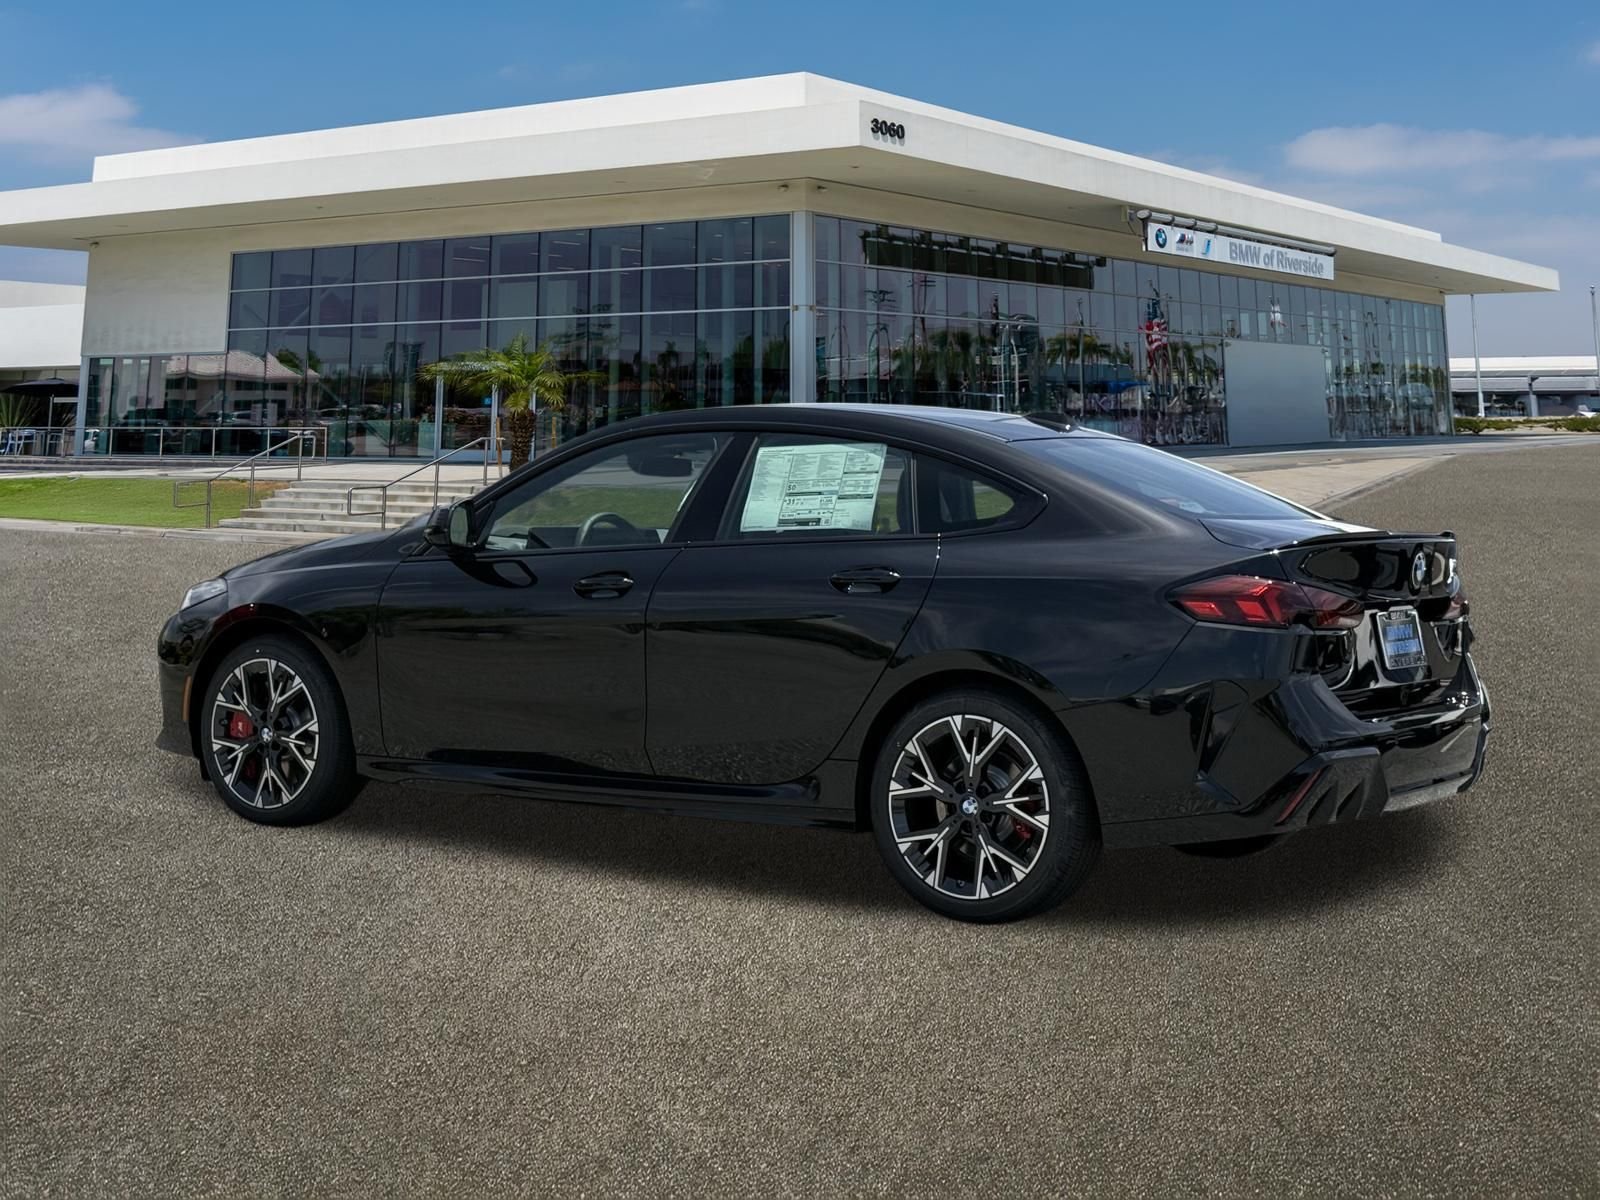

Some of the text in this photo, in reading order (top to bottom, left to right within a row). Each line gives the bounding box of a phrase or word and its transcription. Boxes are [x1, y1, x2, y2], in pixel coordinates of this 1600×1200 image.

[871, 118, 905, 139] 3060
[1229, 241, 1324, 275] BMW of Riverside
